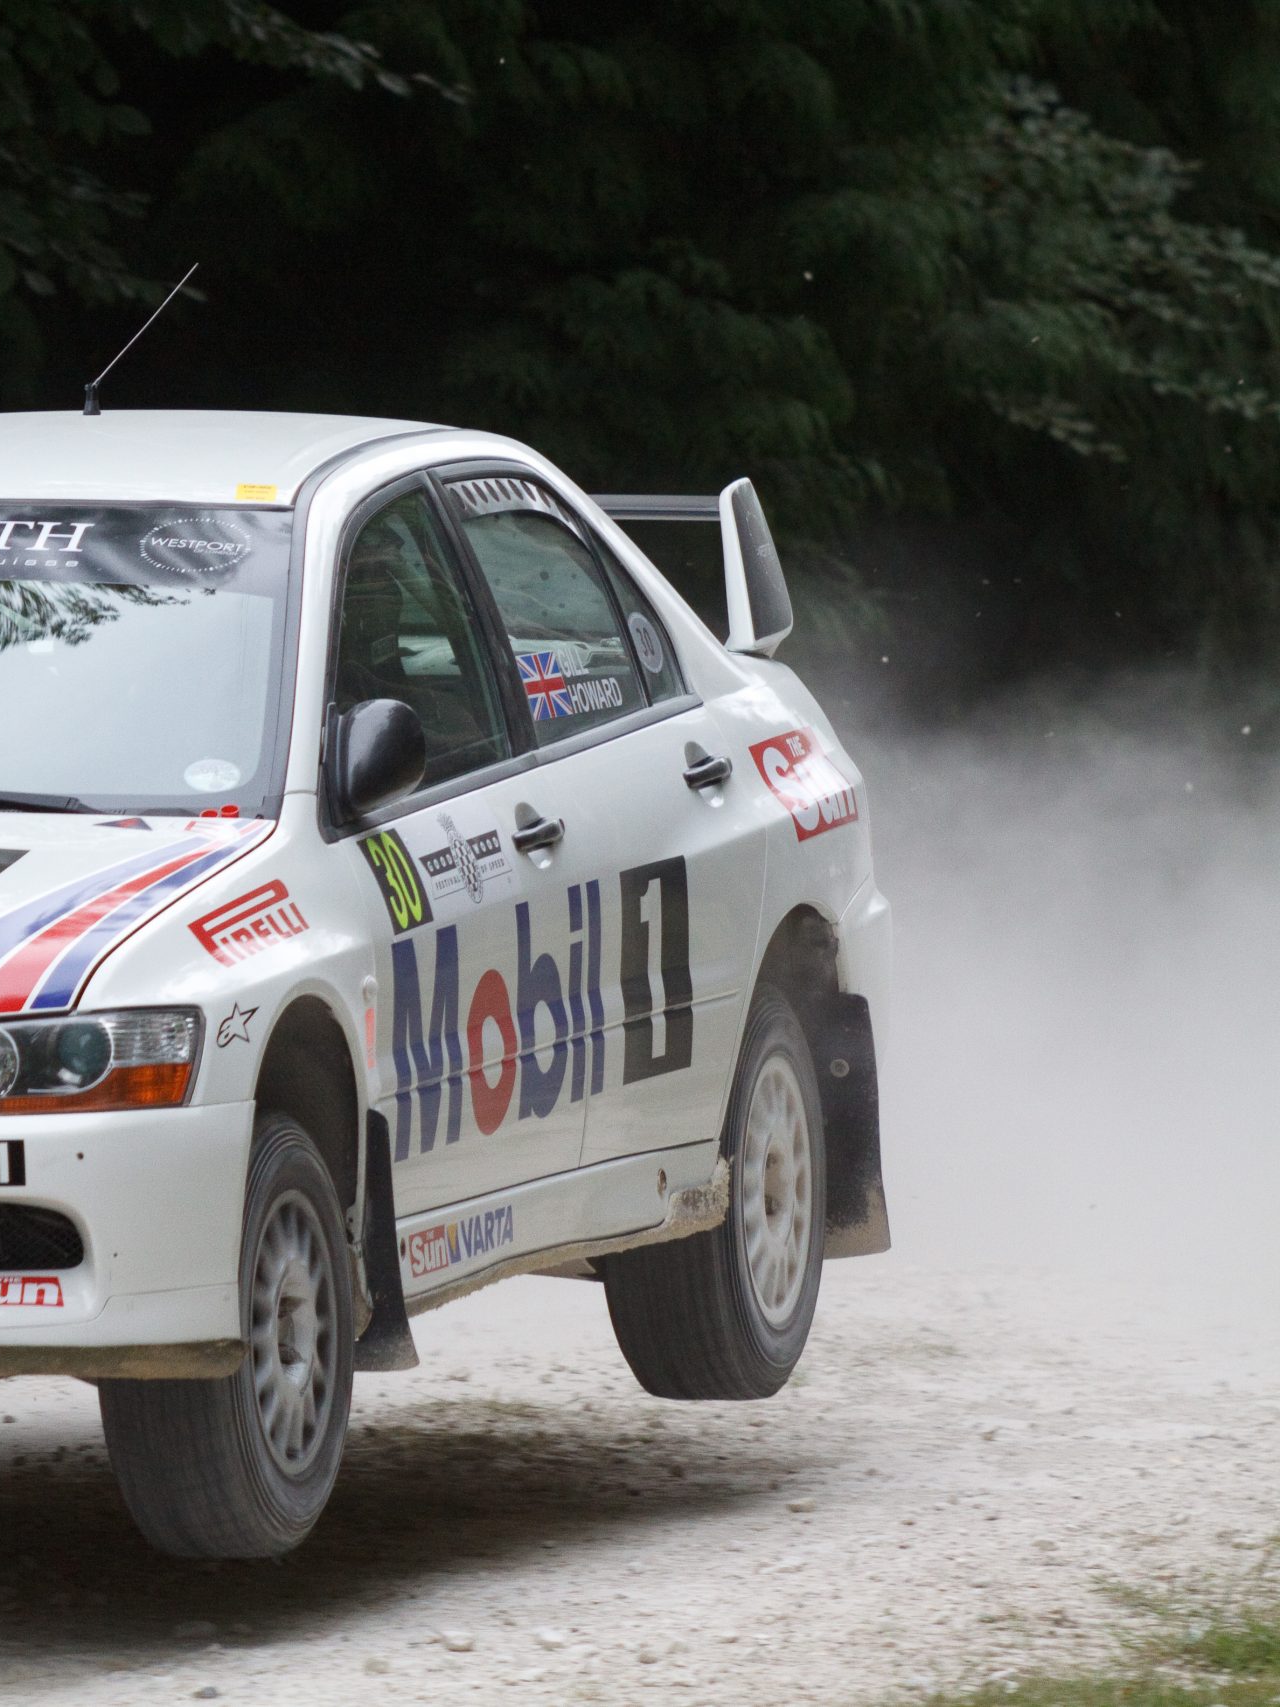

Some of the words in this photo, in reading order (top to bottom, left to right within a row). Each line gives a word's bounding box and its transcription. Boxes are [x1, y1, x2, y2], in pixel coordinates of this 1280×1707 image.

[151, 537, 244, 553] WESTPORT
[557, 648, 590, 678] GILL
[636, 627, 655, 657] 30
[568, 677, 623, 714] HOWARD
[785, 735, 806, 758] THE
[762, 746, 856, 831] Sun
[366, 831, 422, 929] 30
[187, 879, 310, 967] PIRELLI
[391, 879, 605, 1163] Mobil
[411, 1234, 448, 1275] Sun
[461, 1205, 514, 1258] VARTA
